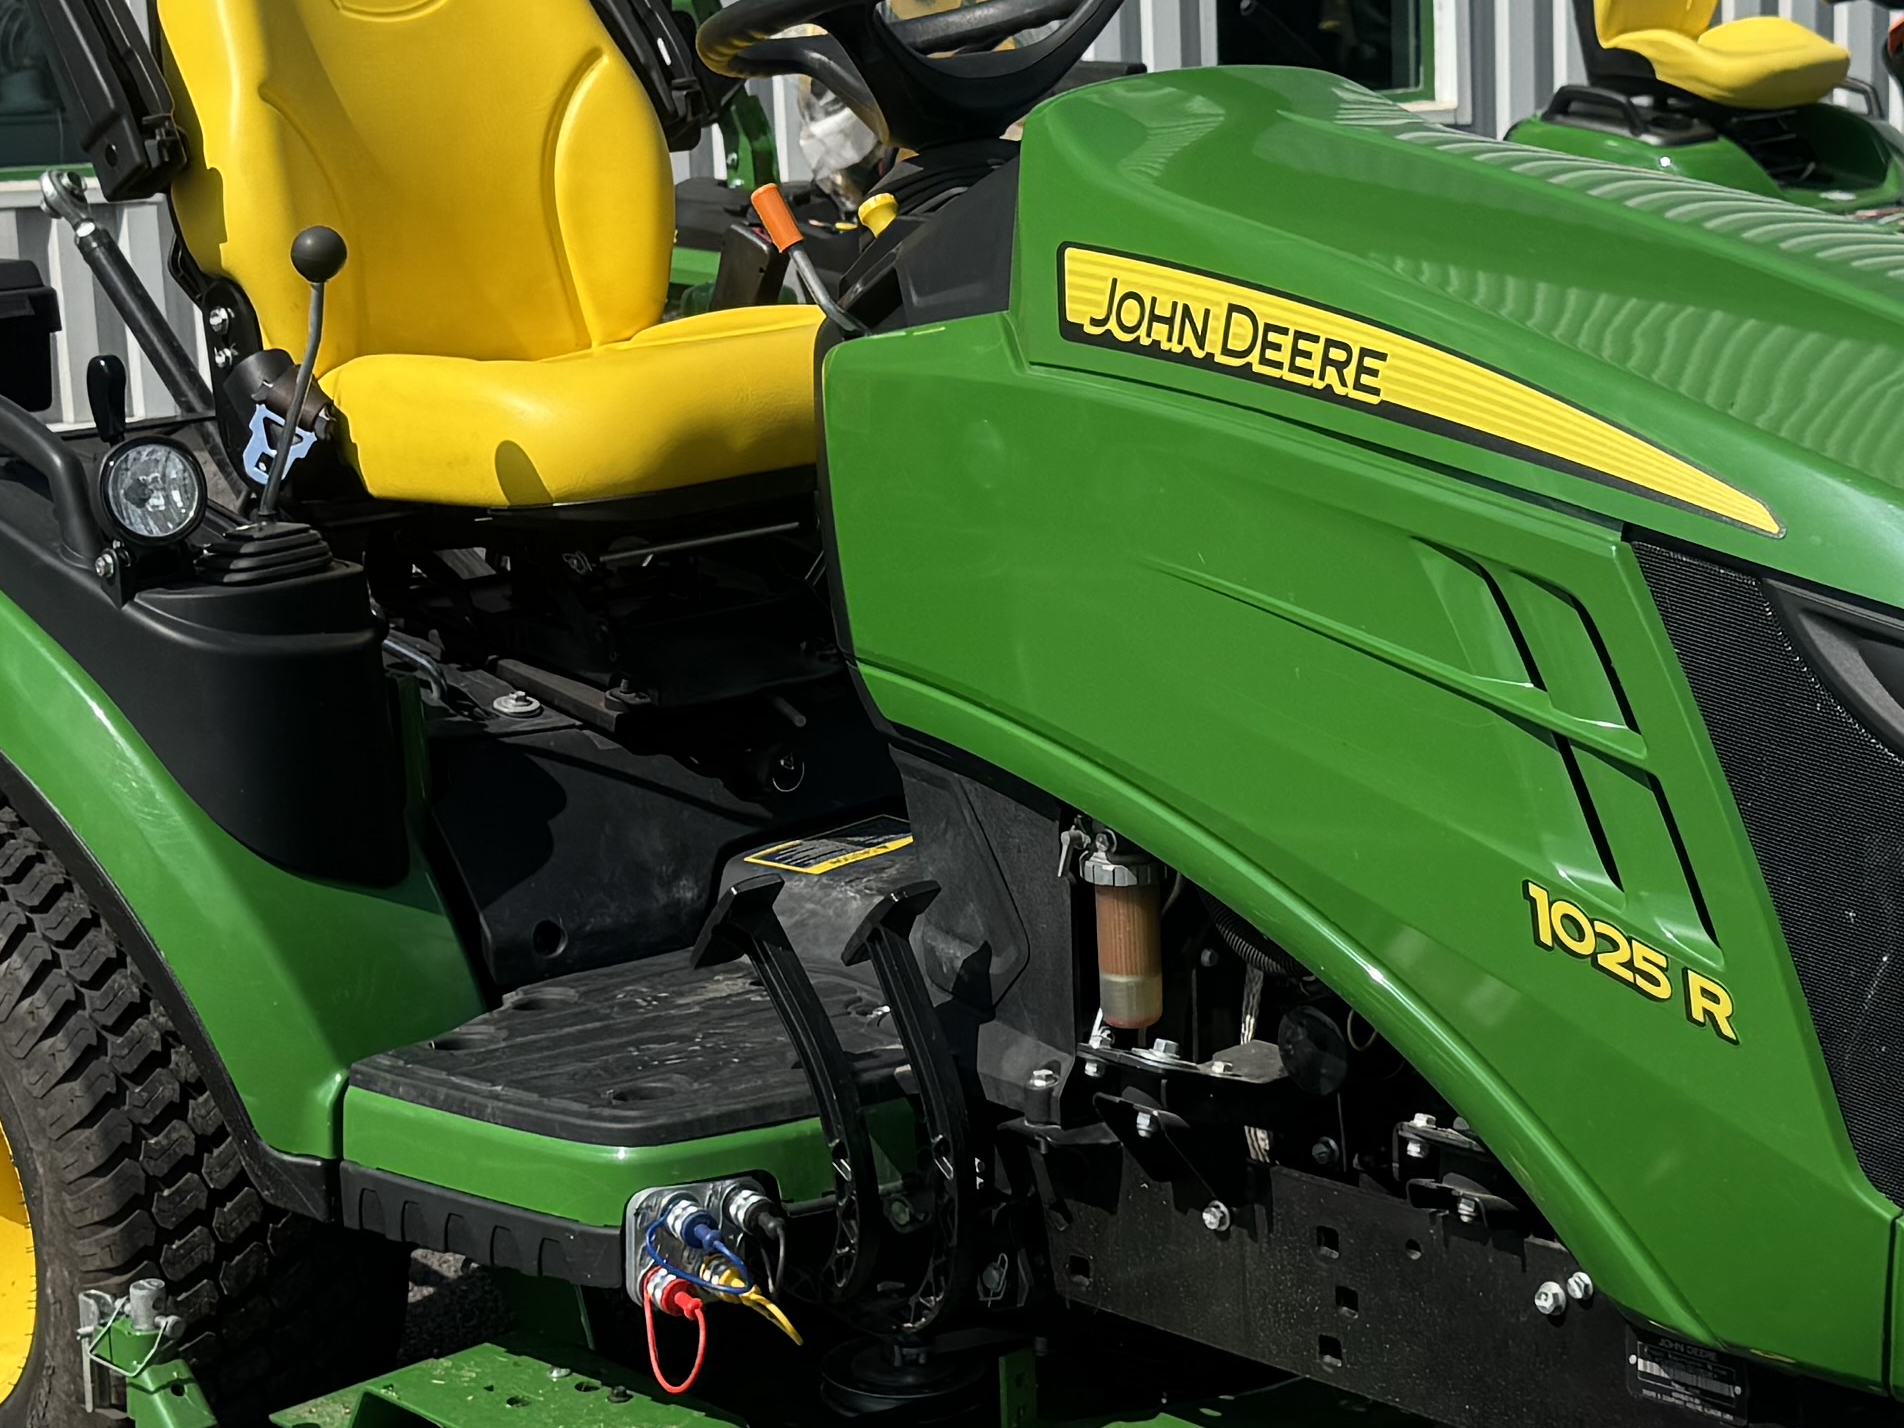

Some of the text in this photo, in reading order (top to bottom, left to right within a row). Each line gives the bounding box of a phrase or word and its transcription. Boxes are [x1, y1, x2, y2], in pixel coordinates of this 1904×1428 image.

[1088, 277, 1389, 398] JOHN DEERE
[1523, 880, 1740, 1046] 1025 R
